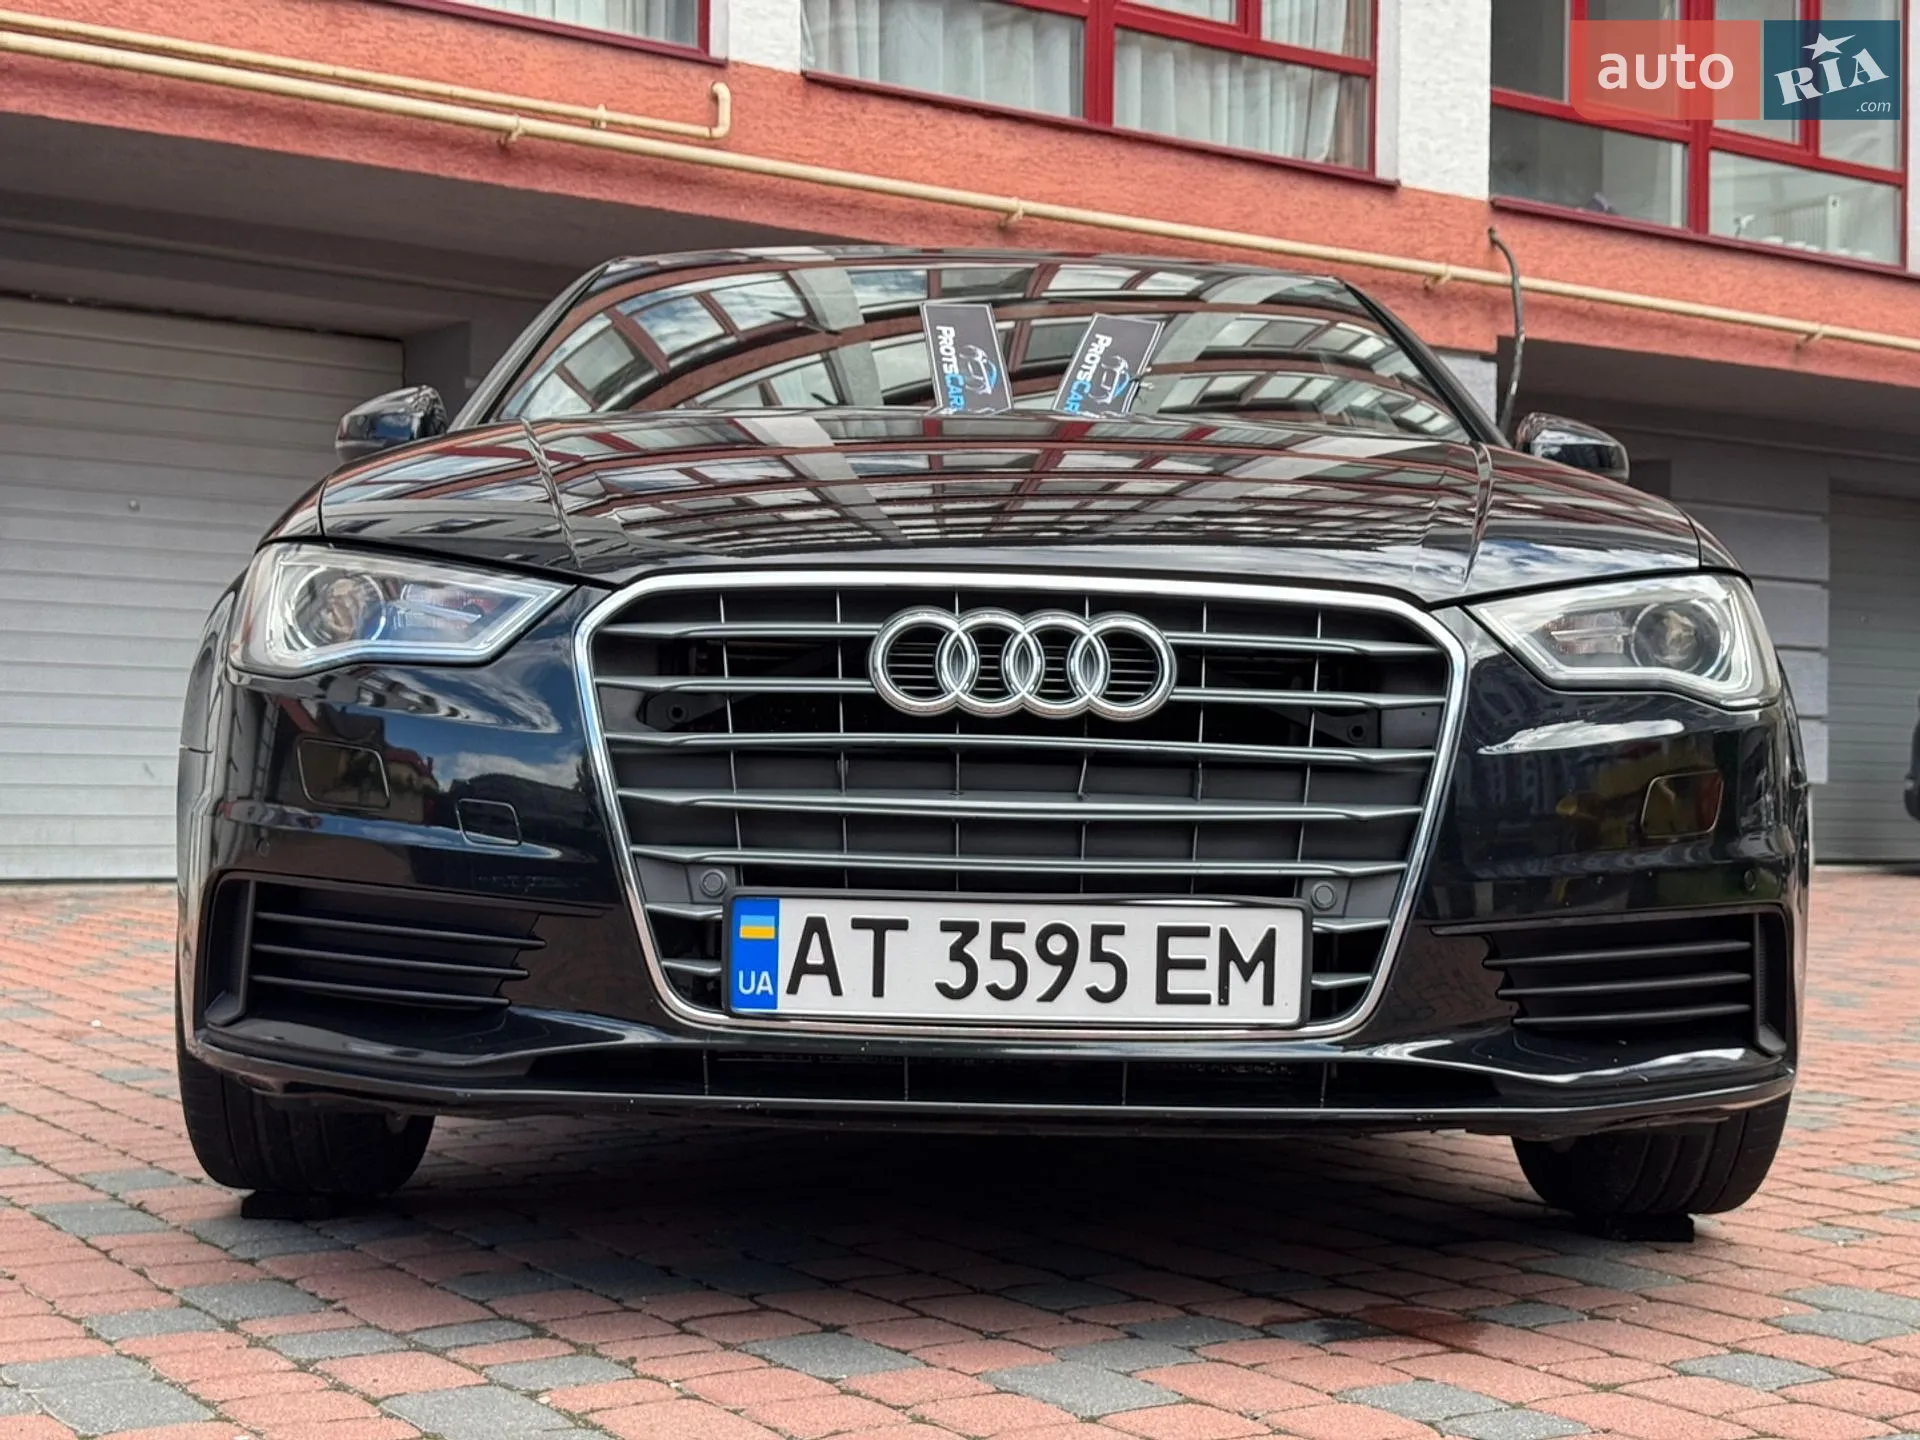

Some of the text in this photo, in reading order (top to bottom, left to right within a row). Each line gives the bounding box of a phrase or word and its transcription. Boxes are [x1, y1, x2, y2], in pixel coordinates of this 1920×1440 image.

[739, 971, 774, 997] UA
[786, 915, 1277, 1006] AT 3595 EM
